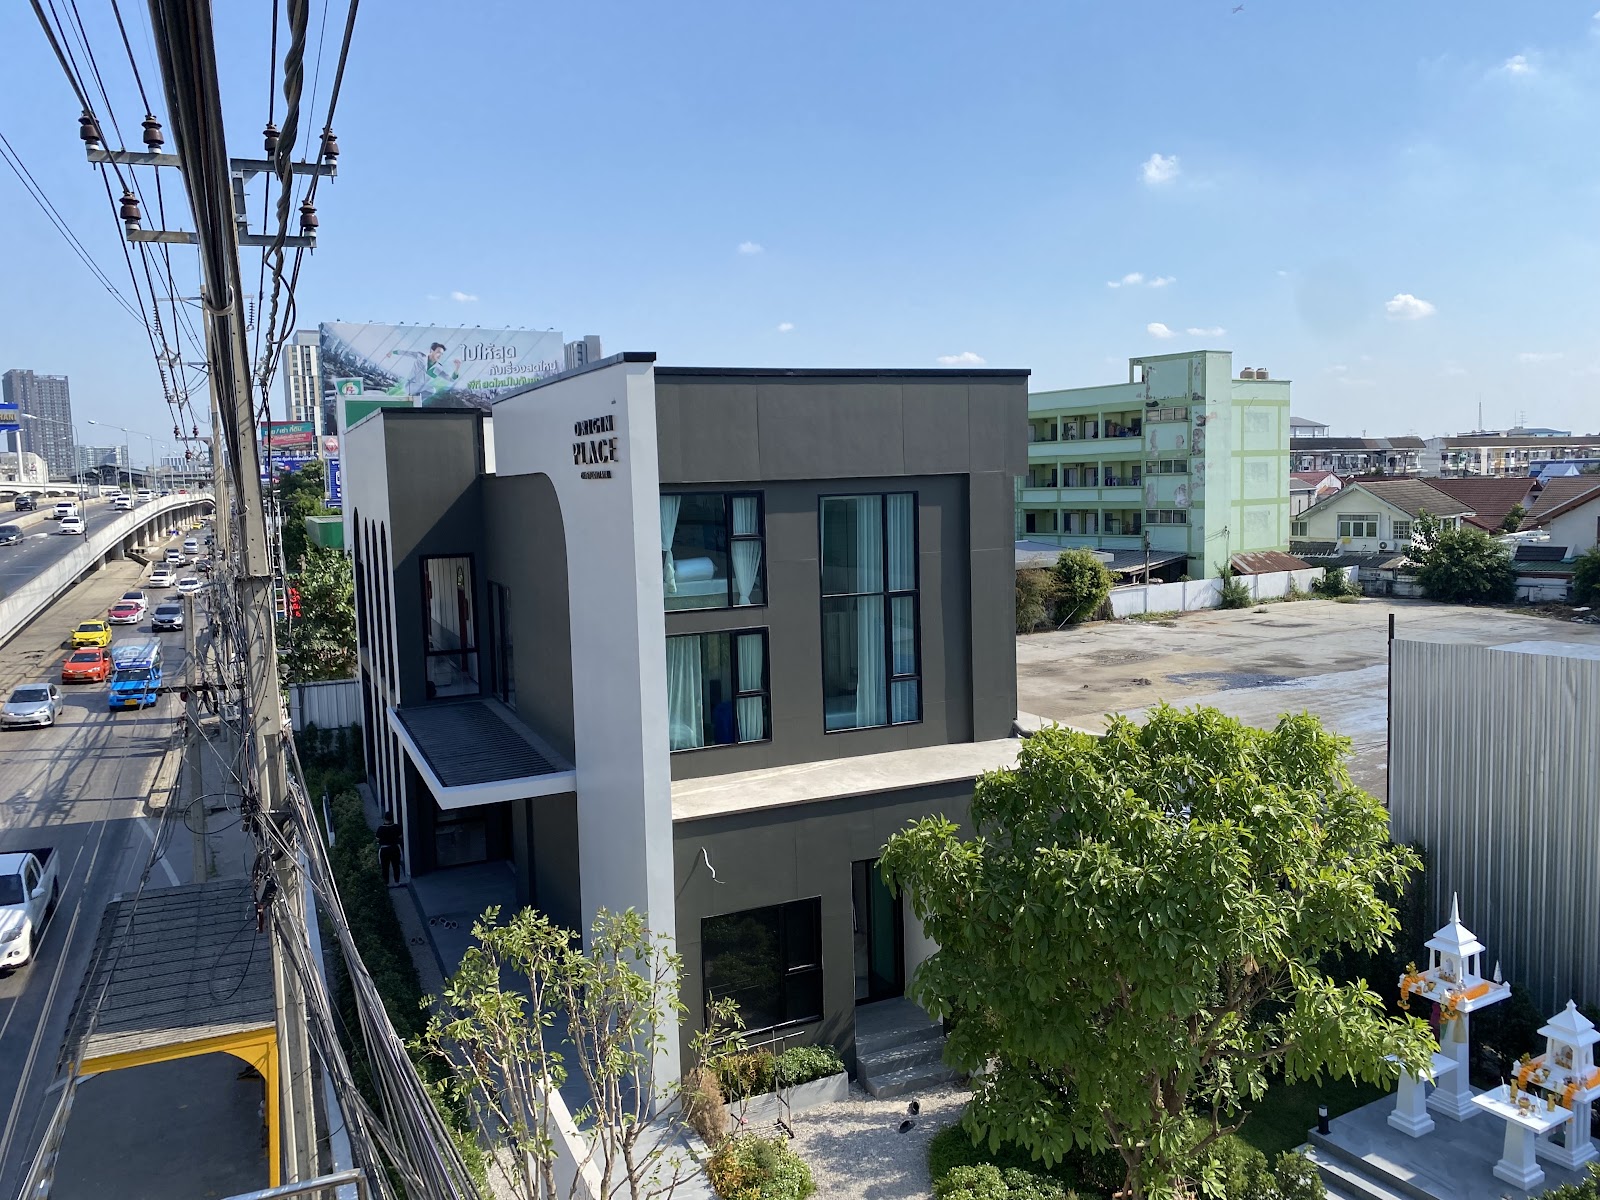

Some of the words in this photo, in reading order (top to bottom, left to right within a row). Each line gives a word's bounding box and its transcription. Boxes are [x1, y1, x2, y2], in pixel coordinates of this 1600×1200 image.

[460, 342, 517, 363] ไปให้สุด
[574, 414, 614, 437] ORIGIN
[572, 437, 619, 465] PLACE
